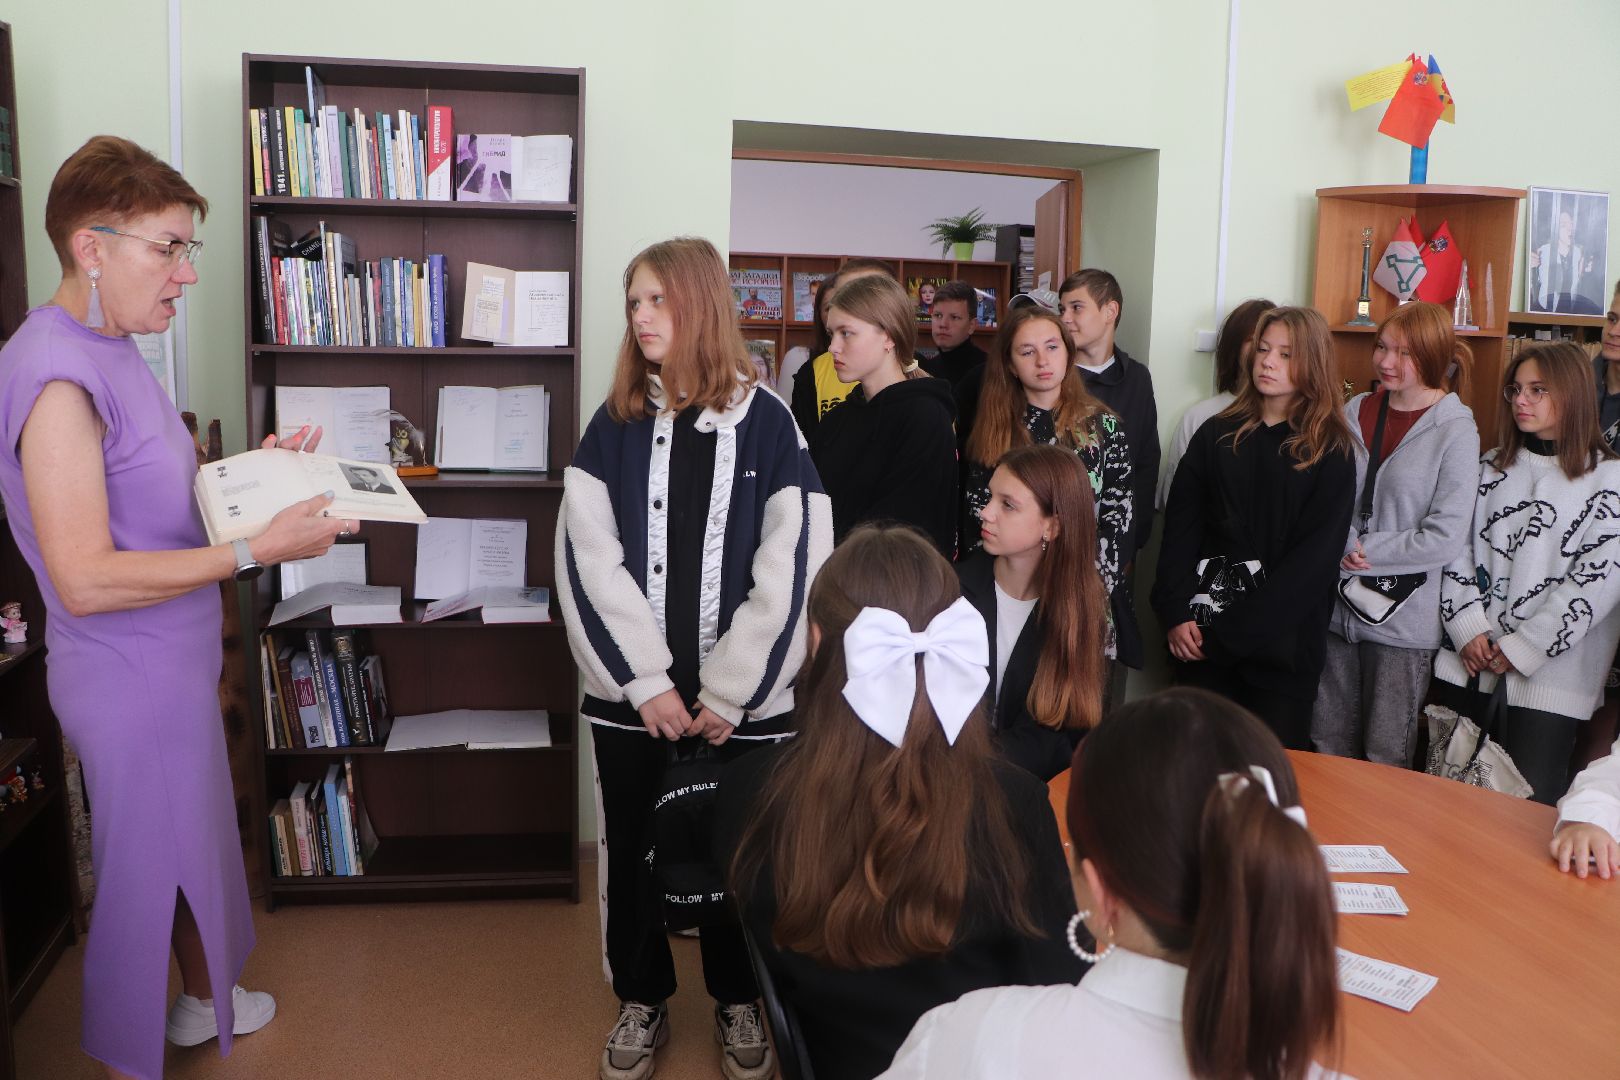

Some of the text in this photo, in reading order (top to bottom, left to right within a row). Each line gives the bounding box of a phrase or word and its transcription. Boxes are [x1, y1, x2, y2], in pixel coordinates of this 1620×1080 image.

[301, 240, 322, 256] CHANEL
[742, 272, 778, 280] ЗАГАДКИ
[742, 278, 779, 287] ИСТОРИИ
[326, 663, 337, 693] МОСКВА
[676, 786, 690, 796] MY
[665, 891, 725, 904] FOLLOW MY
